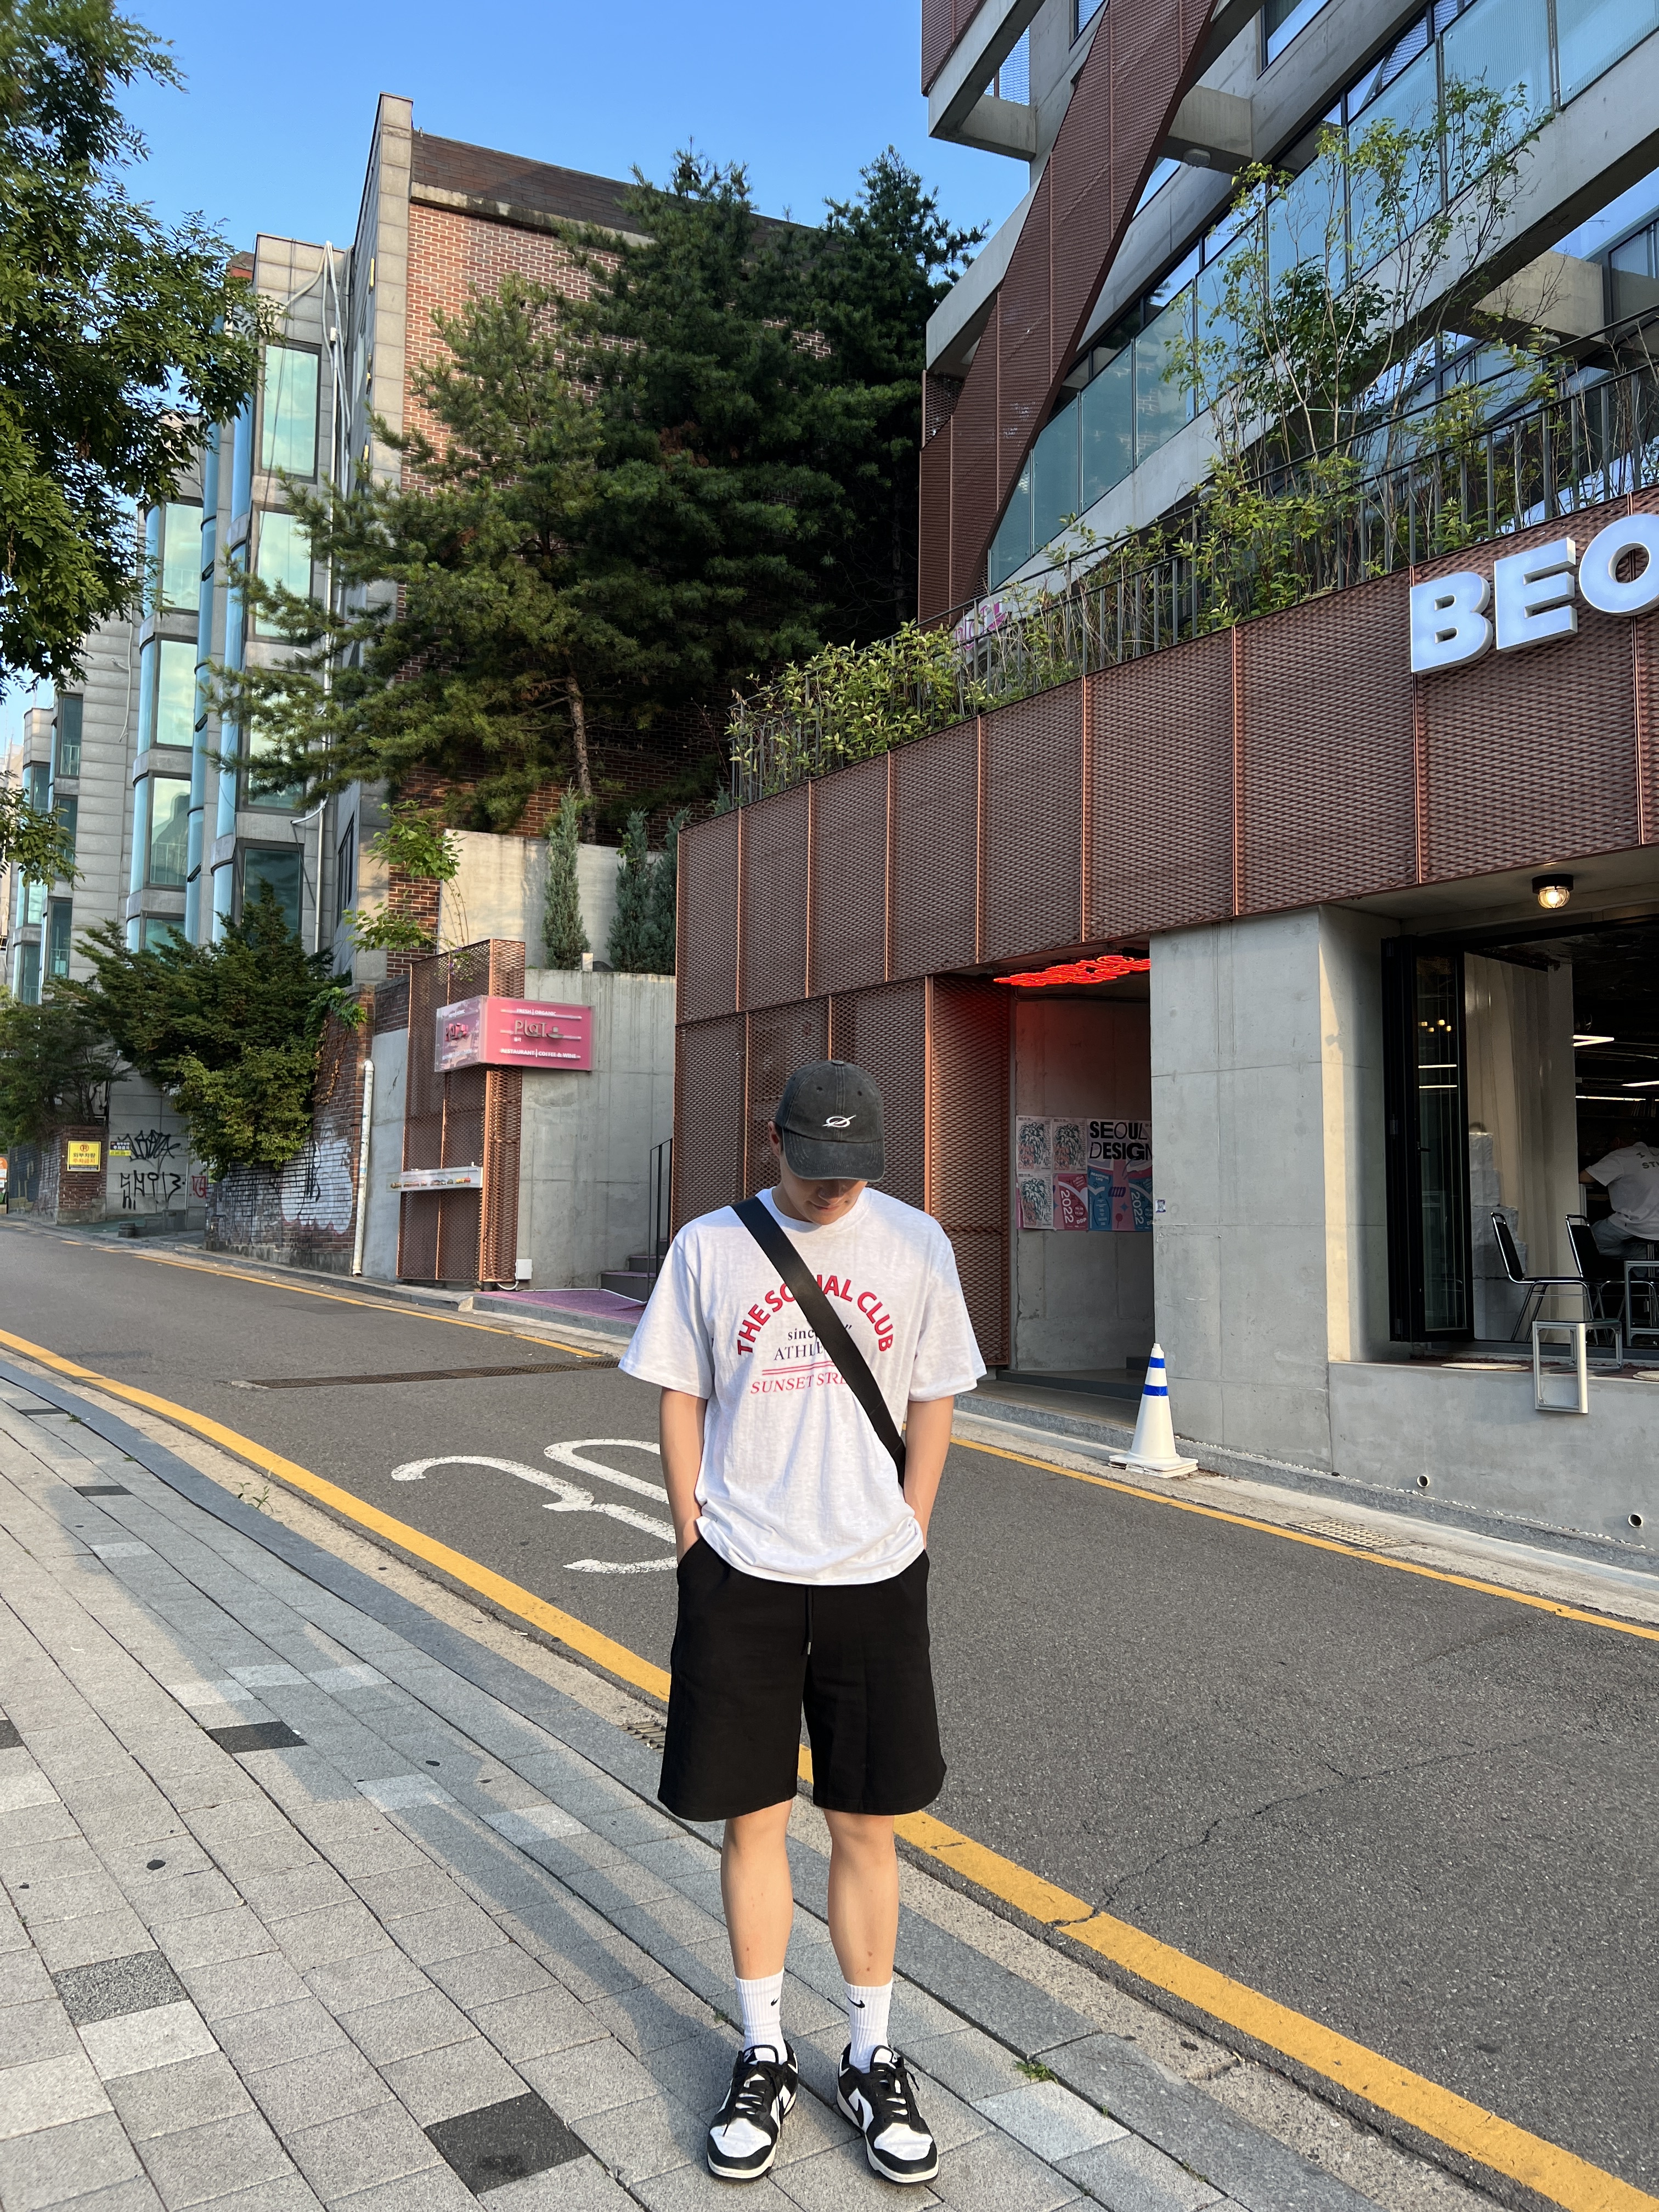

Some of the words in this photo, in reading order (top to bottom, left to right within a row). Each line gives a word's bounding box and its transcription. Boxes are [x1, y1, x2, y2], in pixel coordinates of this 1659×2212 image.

[1090, 1121, 1147, 1140] SEOUL
[1060, 1189, 1074, 1224] 2022
[1131, 1192, 1144, 1226] 2022
[737, 1304, 771, 1356] THE
[765, 1274, 853, 1313] SOIAL
[857, 1291, 894, 1352] CLUB
[788, 1328, 815, 1341] sinc
[750, 1374, 814, 1394] SUNSET
